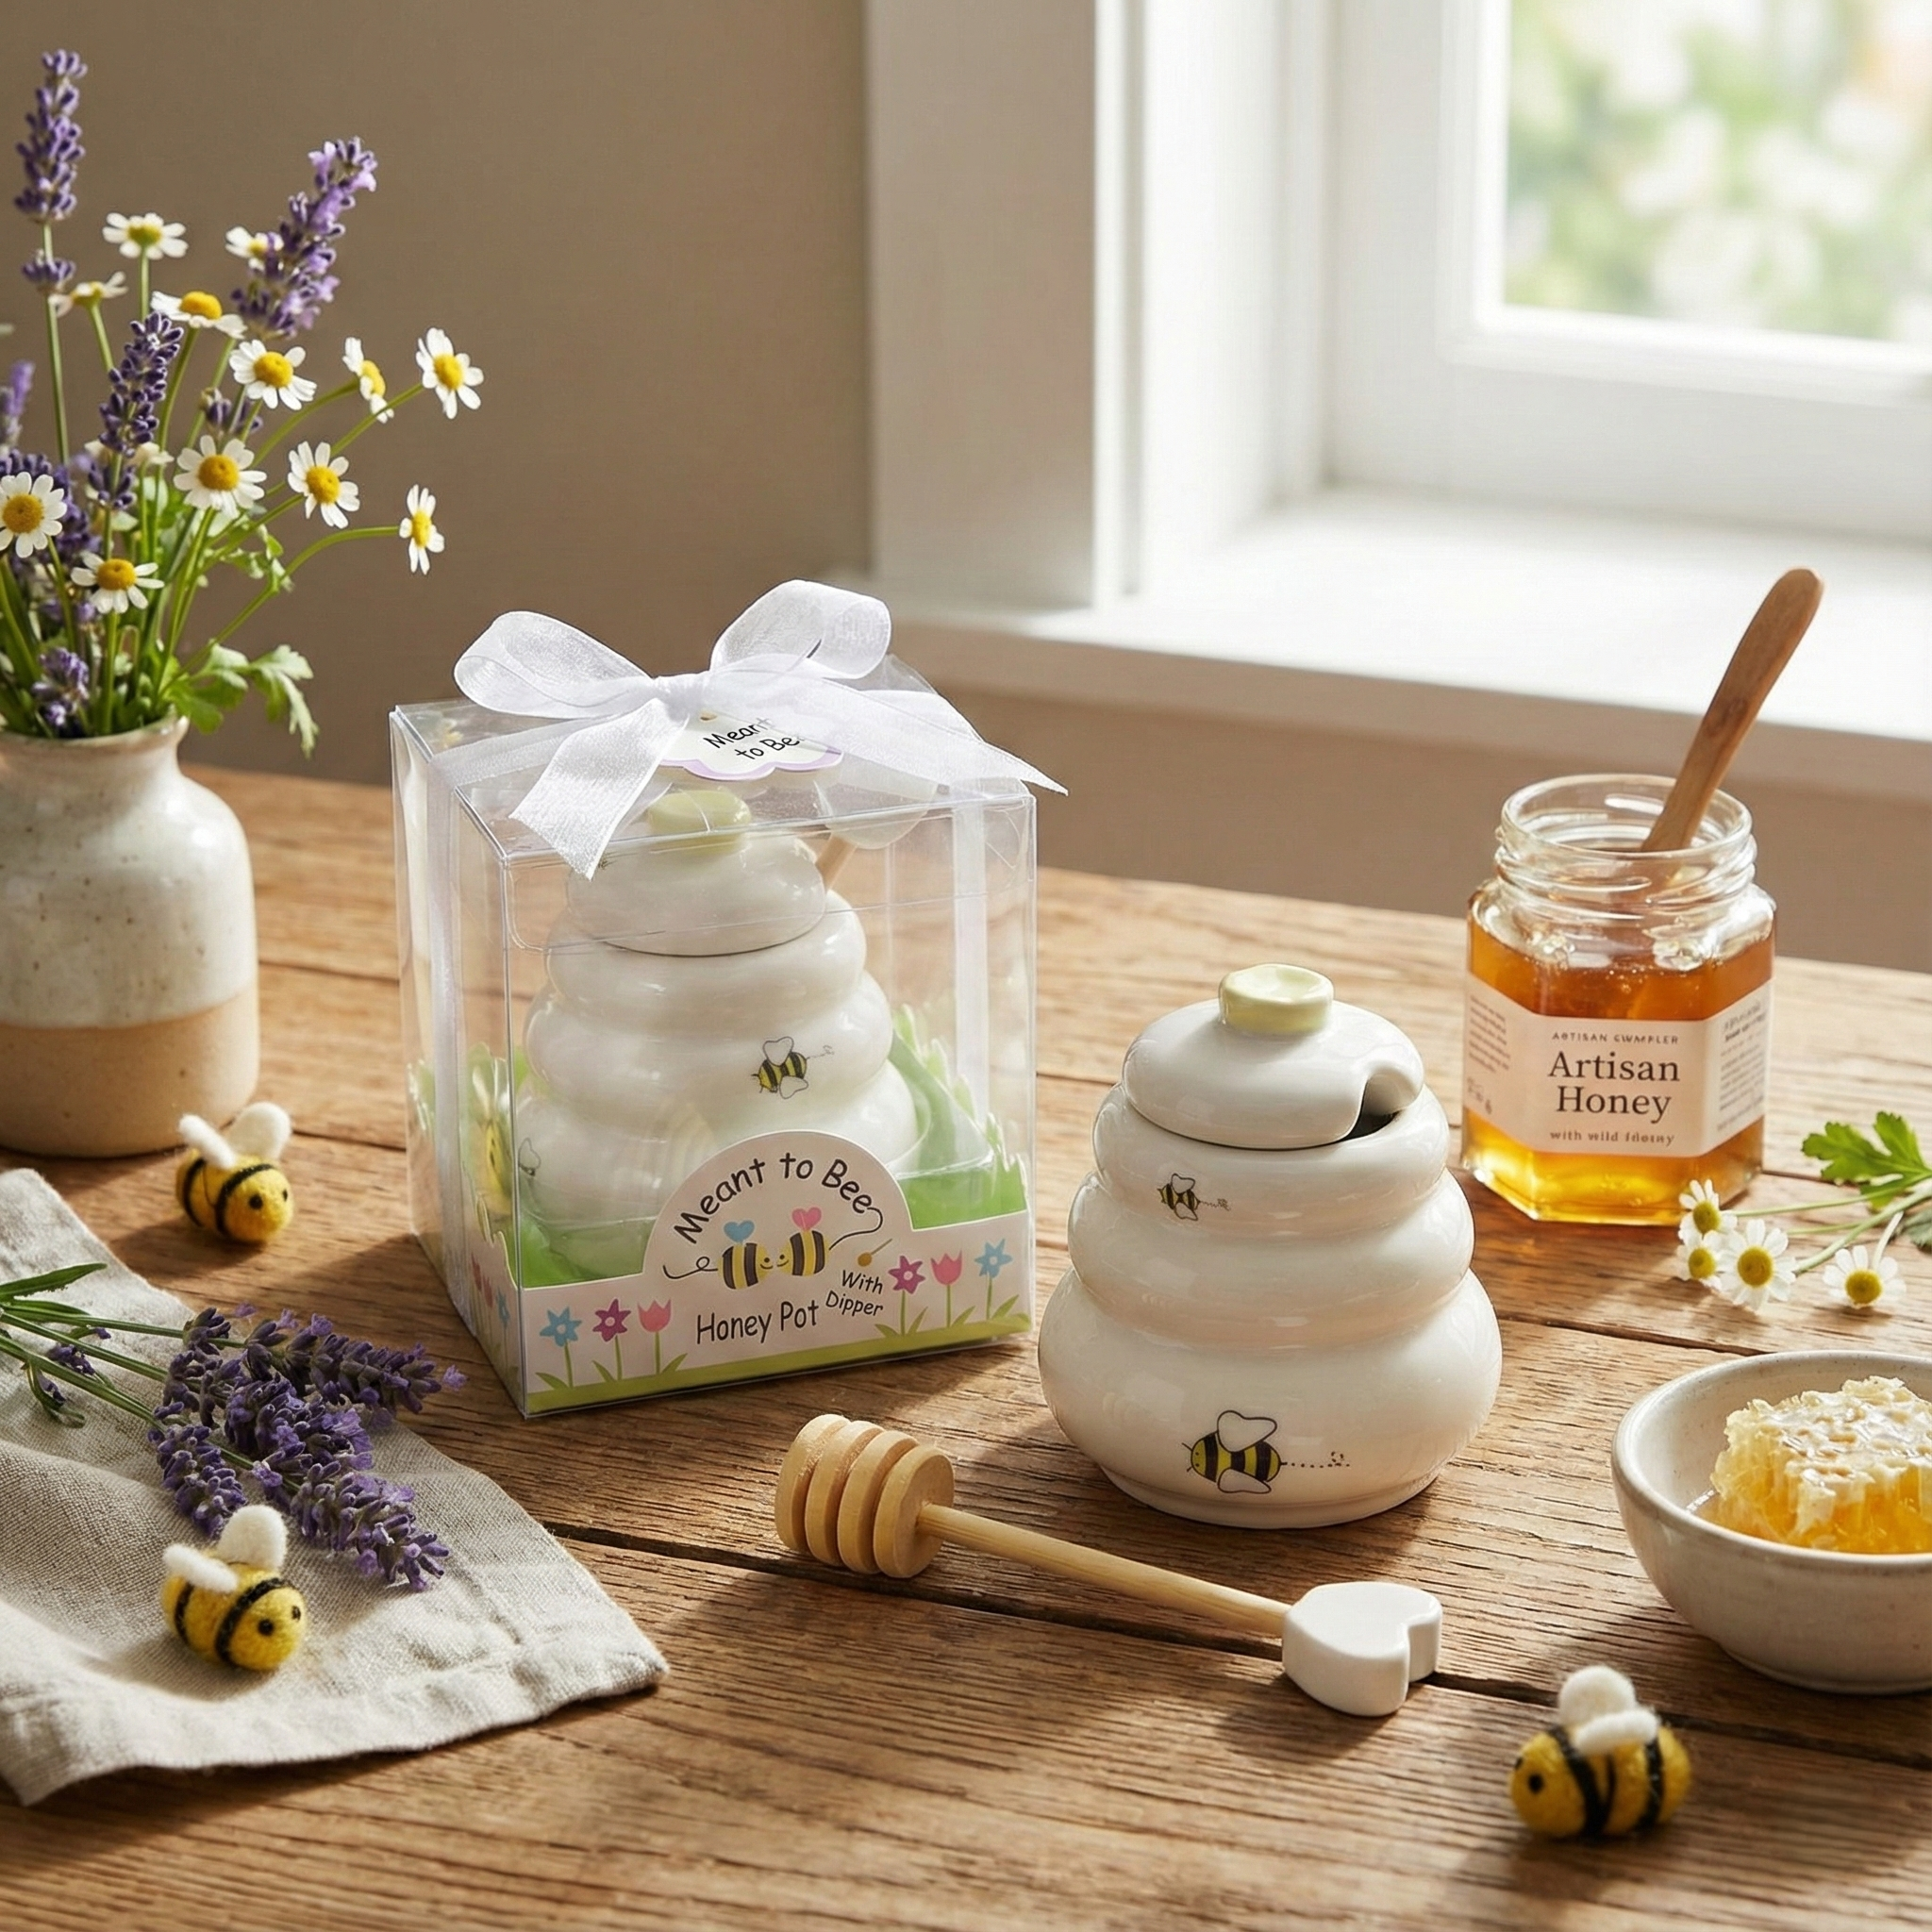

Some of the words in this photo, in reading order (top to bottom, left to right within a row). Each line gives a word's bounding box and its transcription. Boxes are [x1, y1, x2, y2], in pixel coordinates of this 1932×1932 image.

[702, 717, 774, 749] Meant
[734, 747, 765, 760] to
[1548, 1050, 1680, 1082] Artisan
[1556, 1085, 1673, 1124] Honey
[1549, 1129, 1583, 1141] with
[1588, 1130, 1619, 1142] wild
[674, 1158, 766, 1244] Meant
[779, 1152, 814, 1179] to
[821, 1158, 873, 1214] Bee
[841, 1270, 884, 1295] With
[825, 1290, 884, 1317] Dipper
[696, 1312, 773, 1345] Honey
[780, 1299, 820, 1331] Pot
